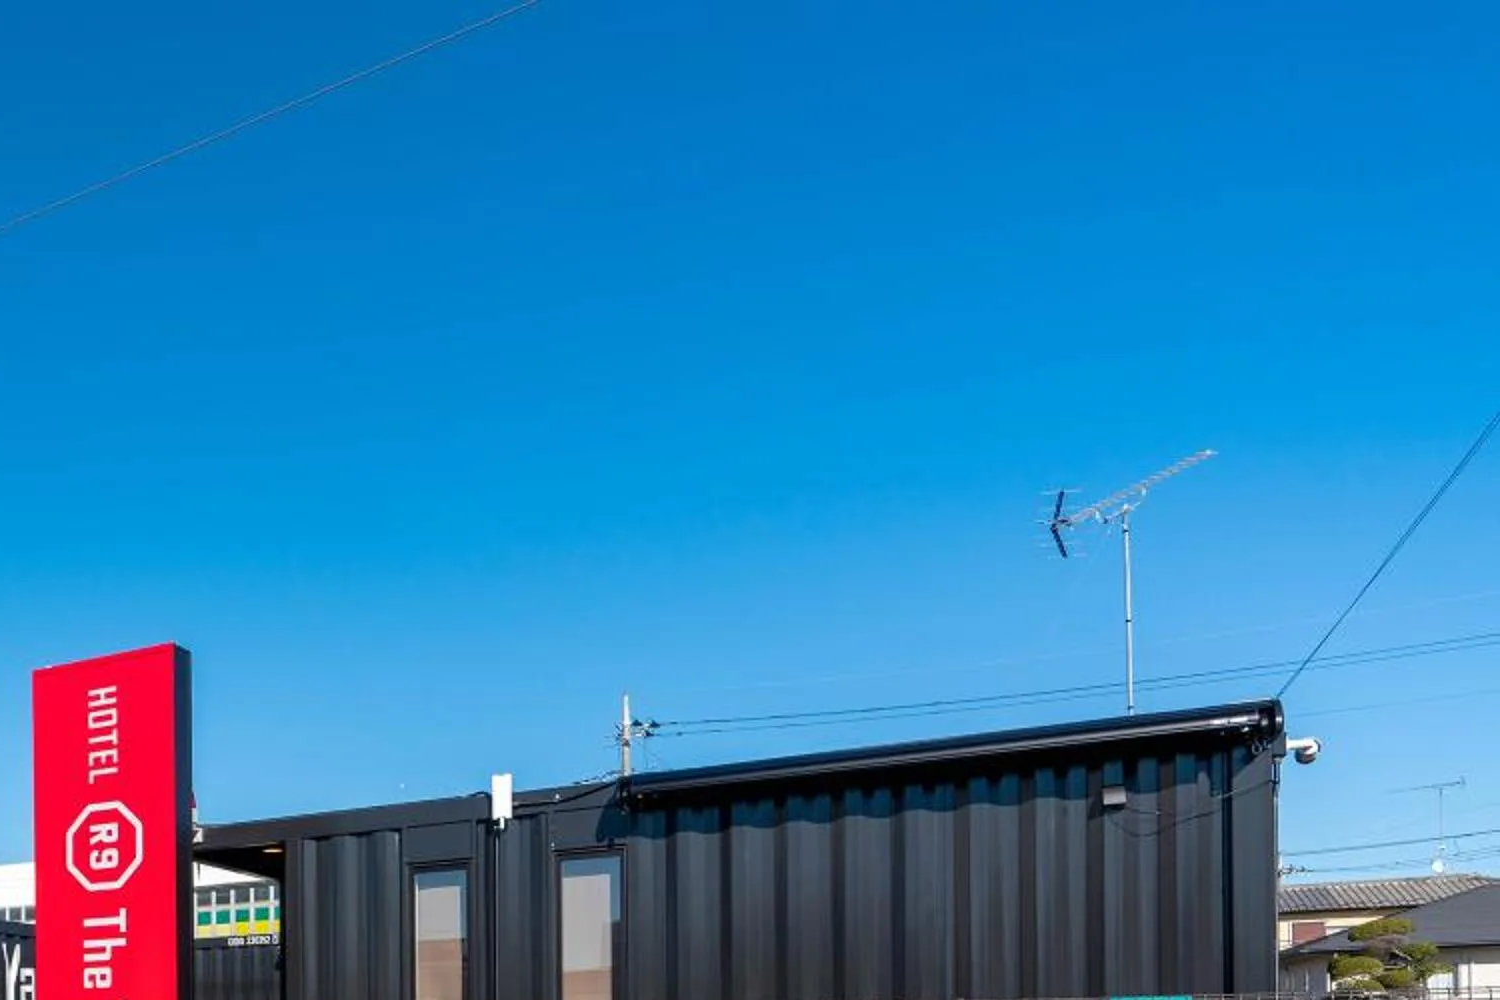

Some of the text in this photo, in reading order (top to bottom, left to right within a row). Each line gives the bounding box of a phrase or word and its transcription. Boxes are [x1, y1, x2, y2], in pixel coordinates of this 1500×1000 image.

[88, 685, 118, 785] HOTEL
[88, 821, 119, 870] R9
[82, 907, 127, 989] The
